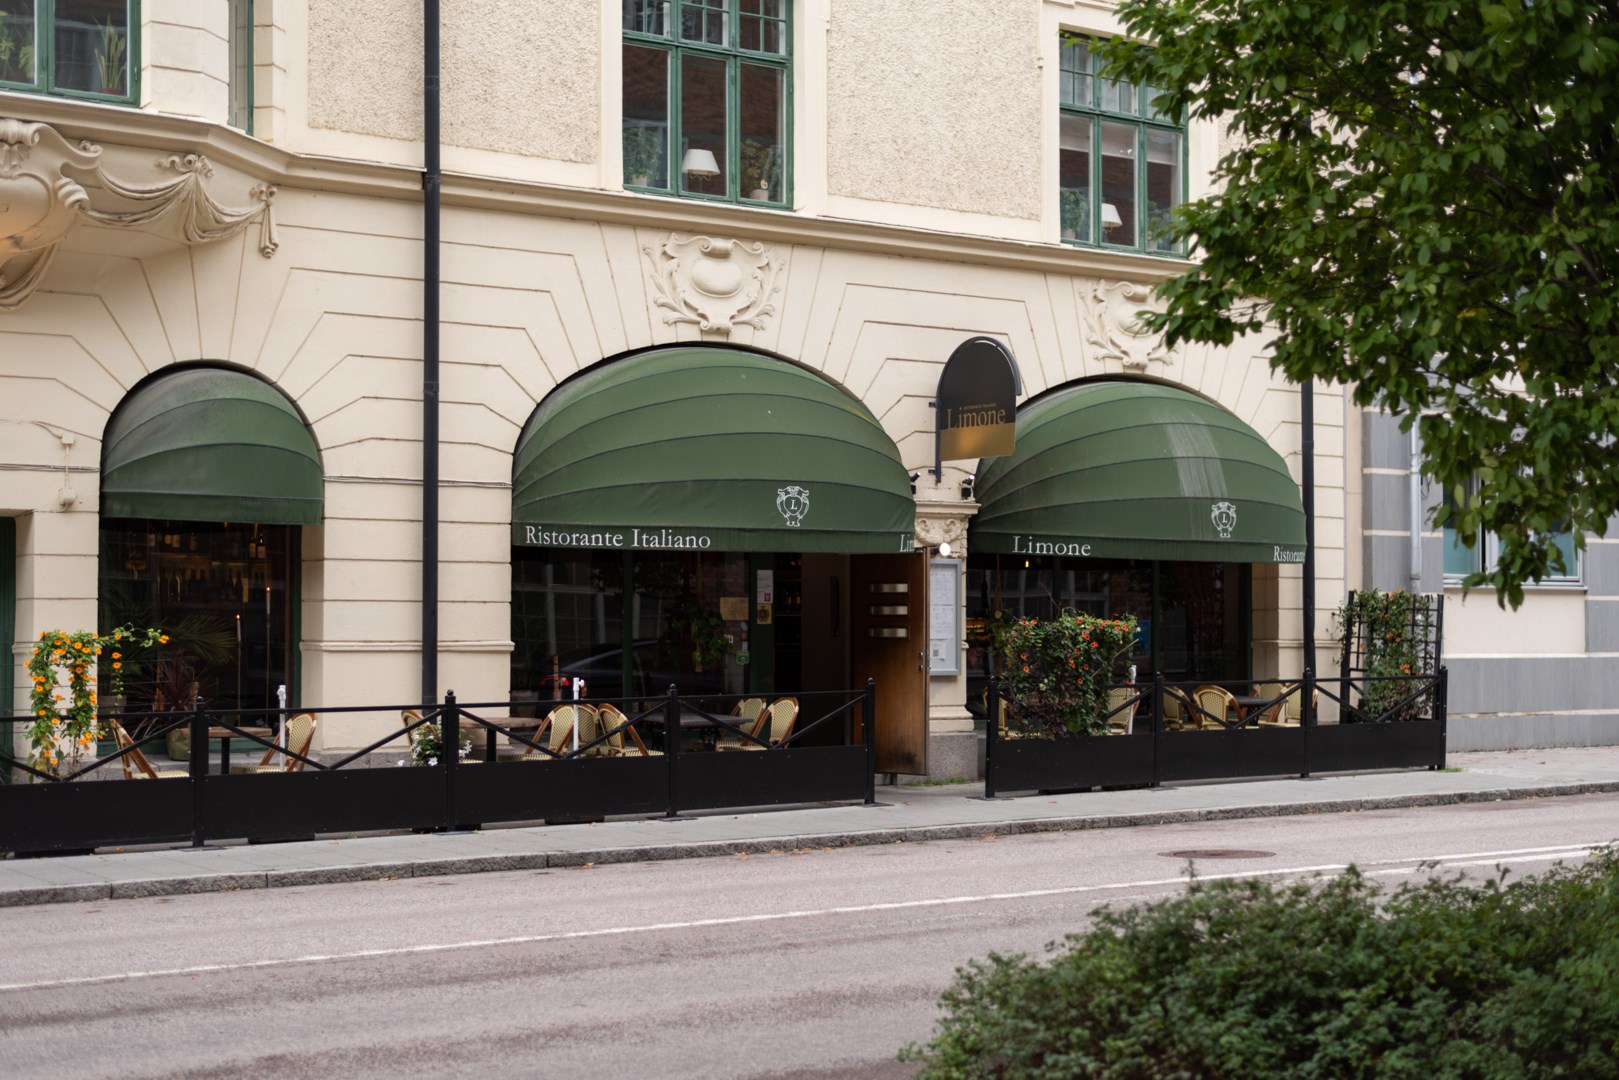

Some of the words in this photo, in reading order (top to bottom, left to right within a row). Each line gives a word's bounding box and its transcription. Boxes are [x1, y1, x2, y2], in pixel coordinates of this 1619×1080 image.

[947, 407, 1006, 429] Limone
[525, 525, 624, 547] Ristorante
[631, 528, 711, 549] Italiano
[1011, 535, 1092, 557] Limone
